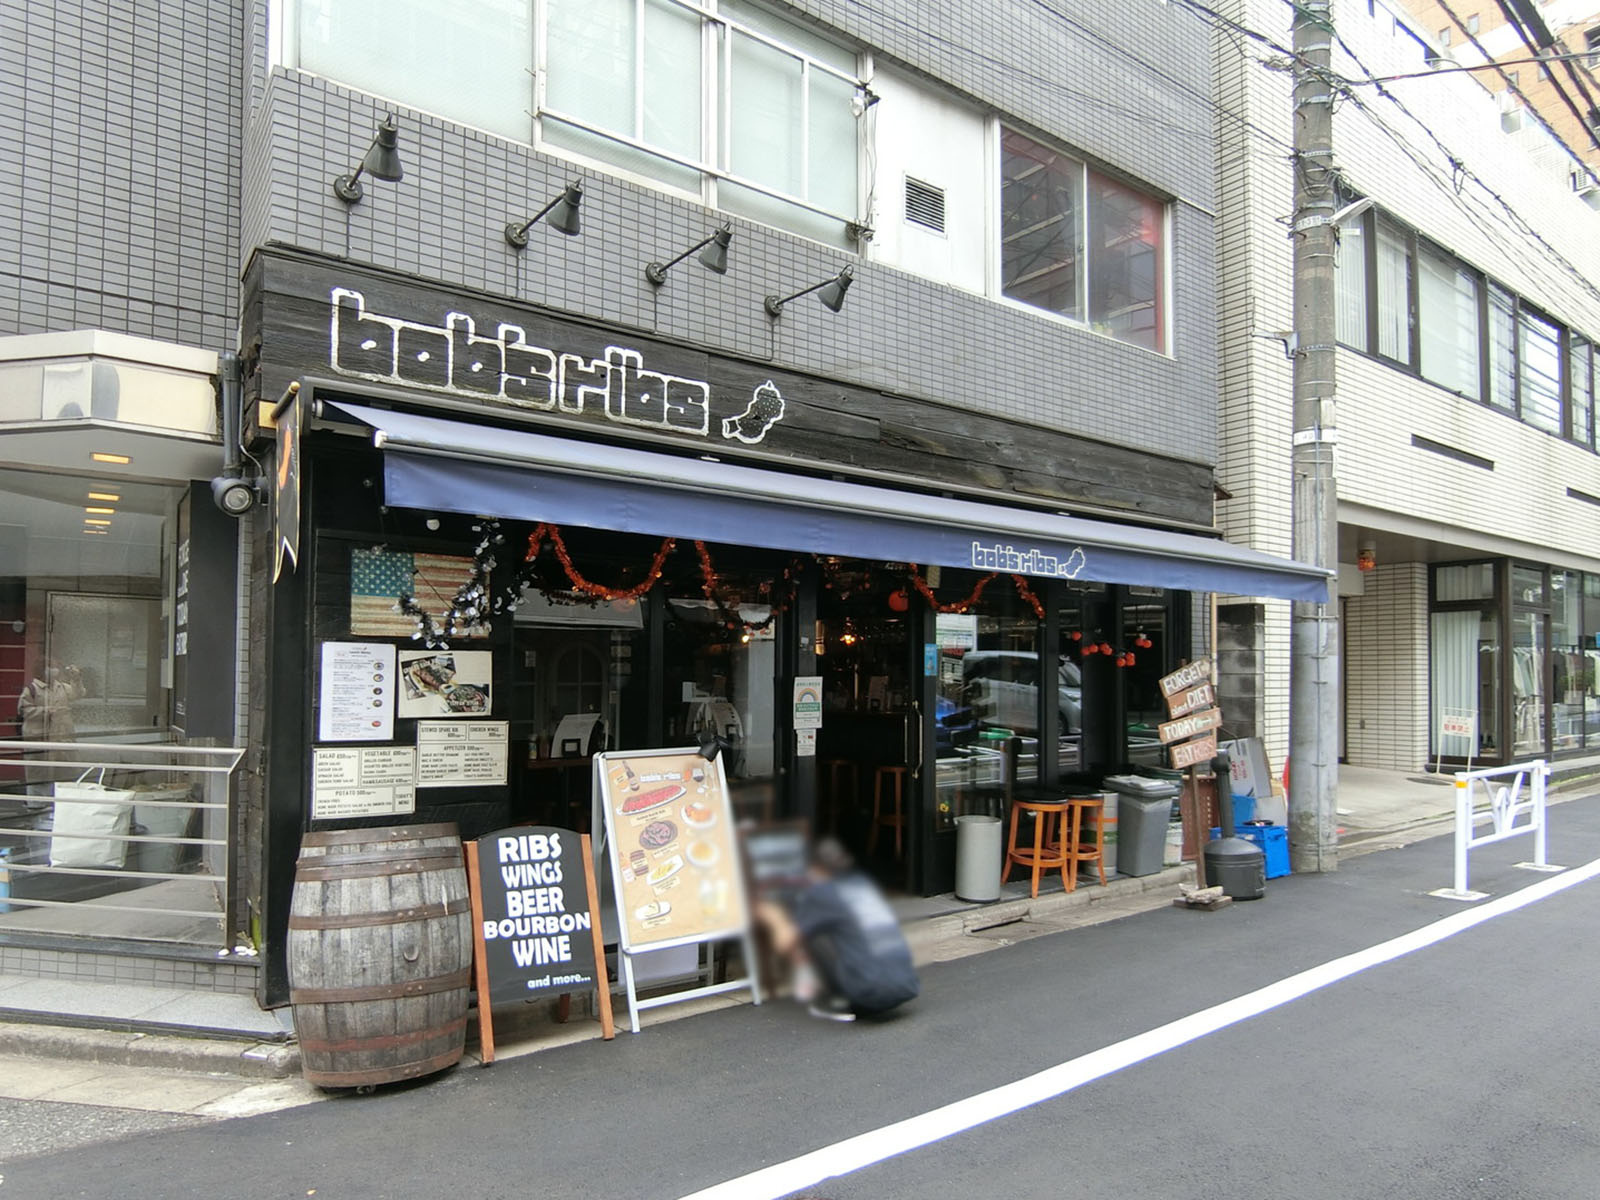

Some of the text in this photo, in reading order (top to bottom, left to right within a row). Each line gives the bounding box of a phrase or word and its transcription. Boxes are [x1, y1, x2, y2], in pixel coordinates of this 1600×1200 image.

[558, 345, 711, 437] ribs
[1020, 549, 1058, 576] ribs
[1163, 660, 1203, 694] FORGET
[1186, 684, 1211, 708] DIET
[1163, 718, 1198, 740] TODAY
[1174, 744, 1192, 764] EAT
[498, 833, 562, 863] RIBS
[502, 860, 564, 888] WINGS
[506, 886, 566, 918] BEER
[484, 912, 591, 940] BOURBON
[512, 935, 572, 968] WINE
[528, 973, 592, 988] and more...
